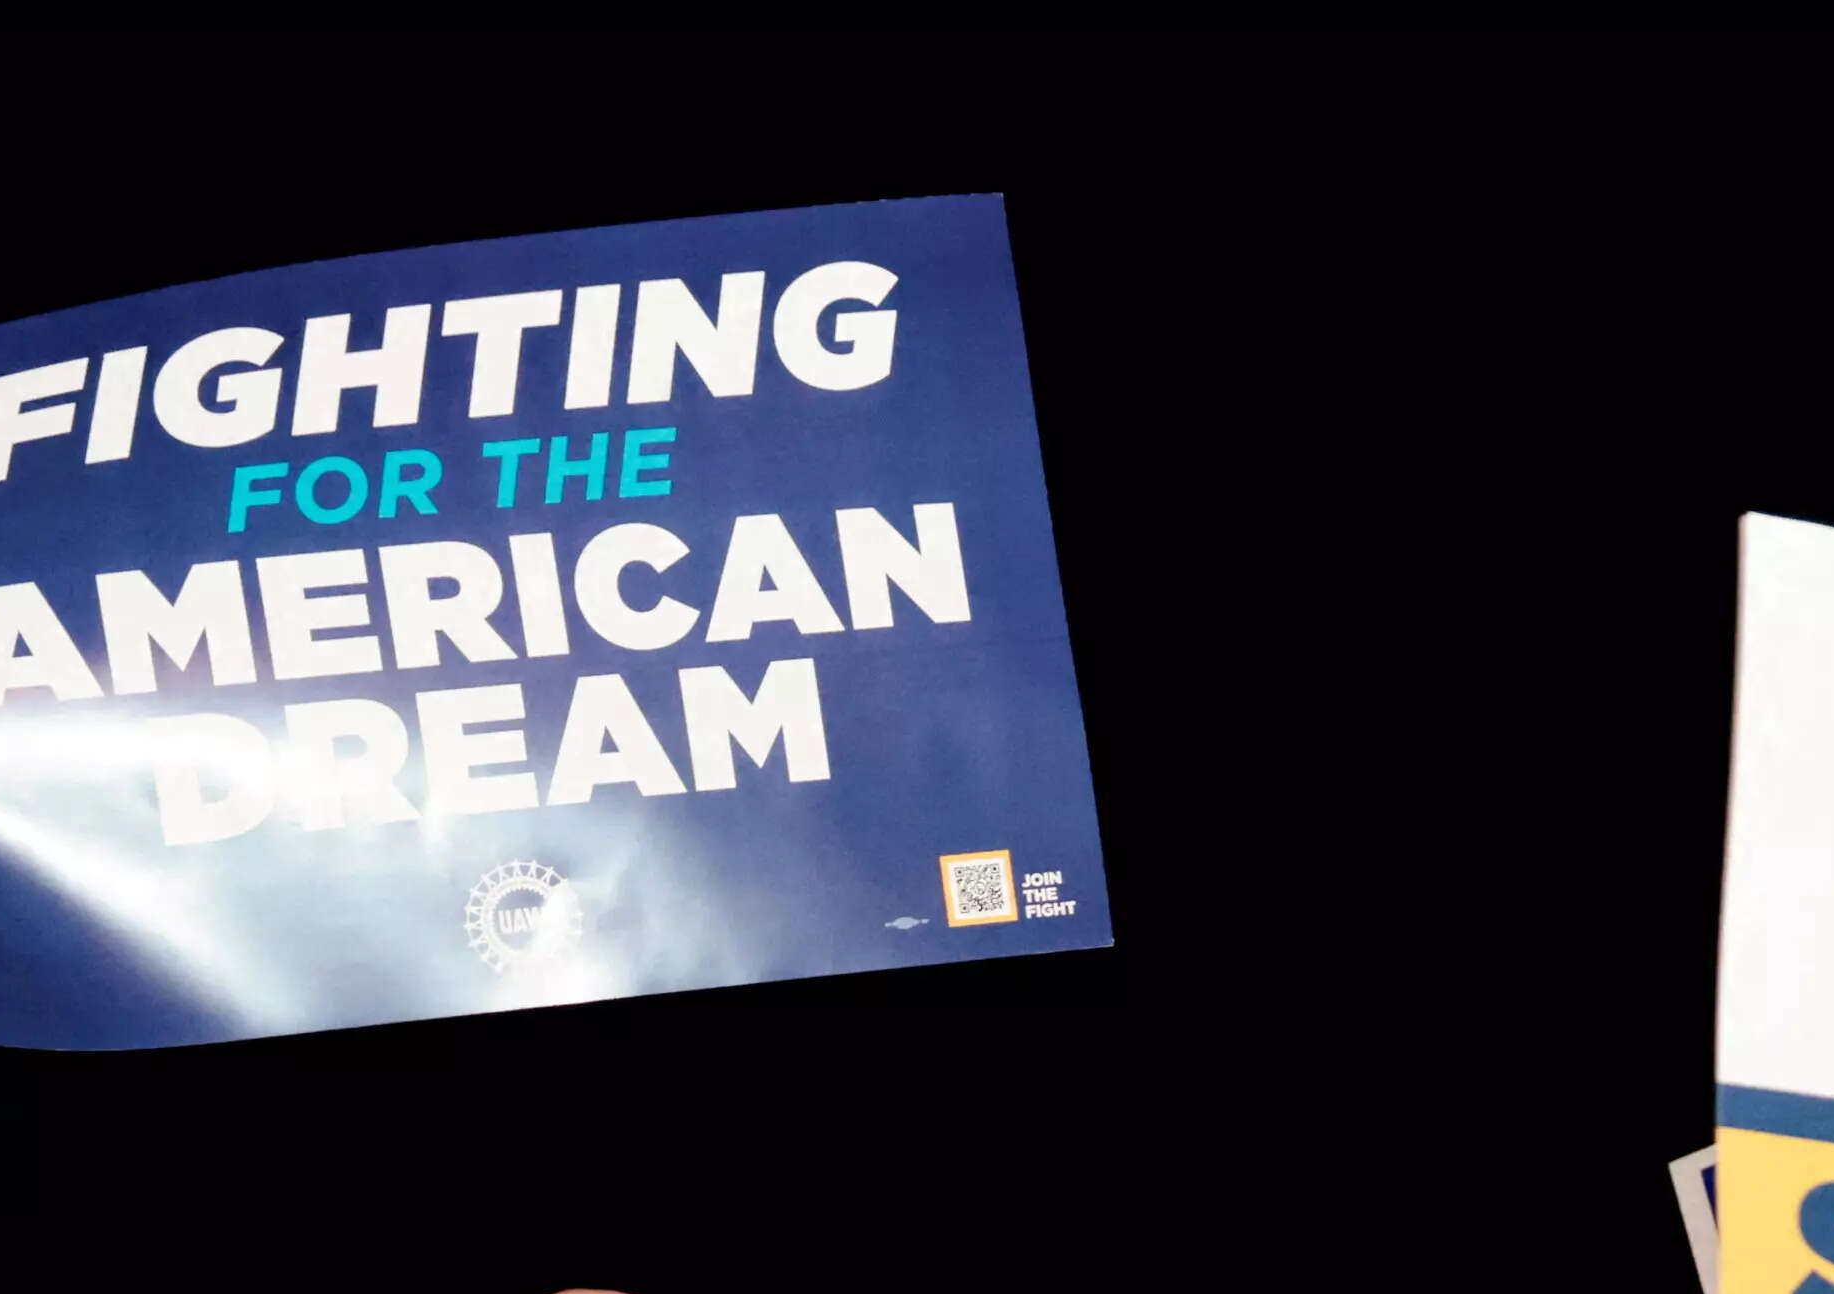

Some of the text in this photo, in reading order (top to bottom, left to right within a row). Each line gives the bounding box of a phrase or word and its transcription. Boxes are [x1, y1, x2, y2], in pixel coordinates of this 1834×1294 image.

[227, 426, 678, 533] FOR THE
[145, 657, 831, 846] DREAM
[1021, 870, 1063, 888] JOIN
[1022, 887, 1058, 904] THE
[1025, 900, 1077, 919] FIGHT
